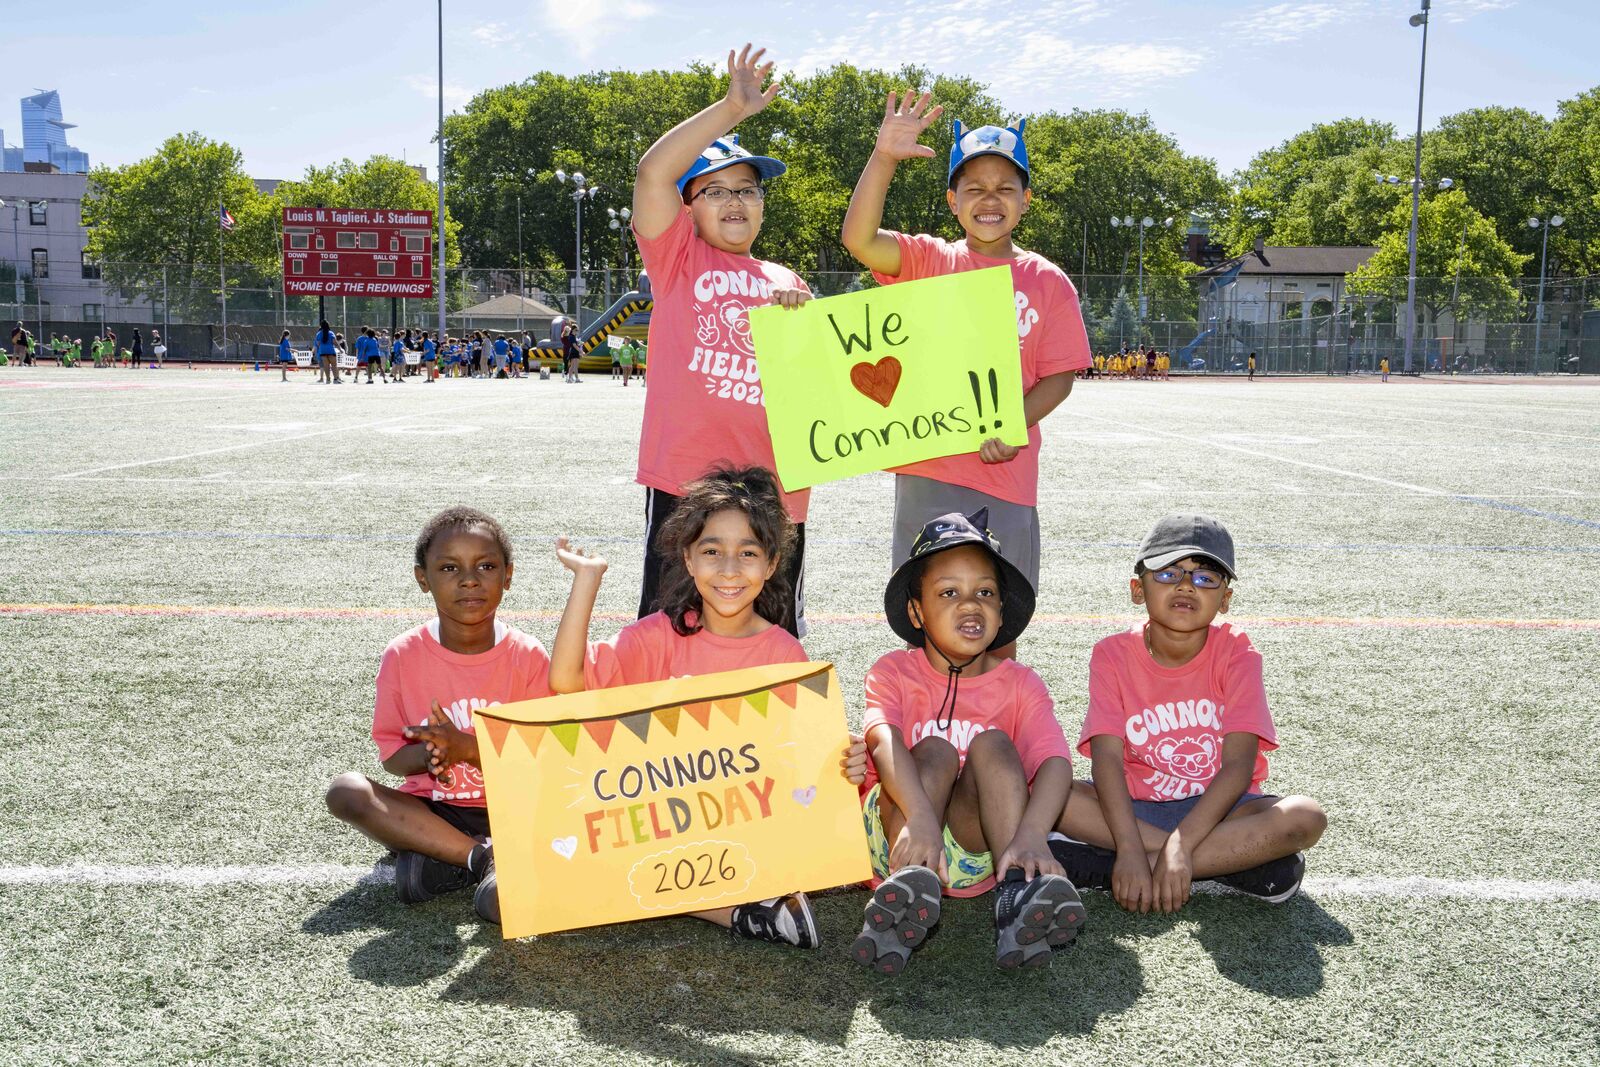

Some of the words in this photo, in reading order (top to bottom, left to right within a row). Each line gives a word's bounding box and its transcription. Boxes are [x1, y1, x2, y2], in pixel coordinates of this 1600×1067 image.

[287, 210, 313, 222] Louis
[316, 211, 328, 222] M.
[331, 211, 370, 225] Taglieri,
[373, 212, 385, 224] Jr.
[388, 212, 428, 224] Stadium
[287, 281, 324, 291] "HOME
[325, 282, 341, 291] OF
[344, 282, 364, 292] THE
[366, 283, 430, 294] REDWINGS"
[694, 270, 776, 302] CONN
[827, 303, 909, 355] We
[688, 346, 760, 383] FIELD
[1125, 699, 1225, 746] CONNO
[593, 743, 761, 801] CONNORS
[584, 796, 692, 854] FIELD
[699, 776, 775, 831] DAY
[654, 848, 737, 894] 2026
